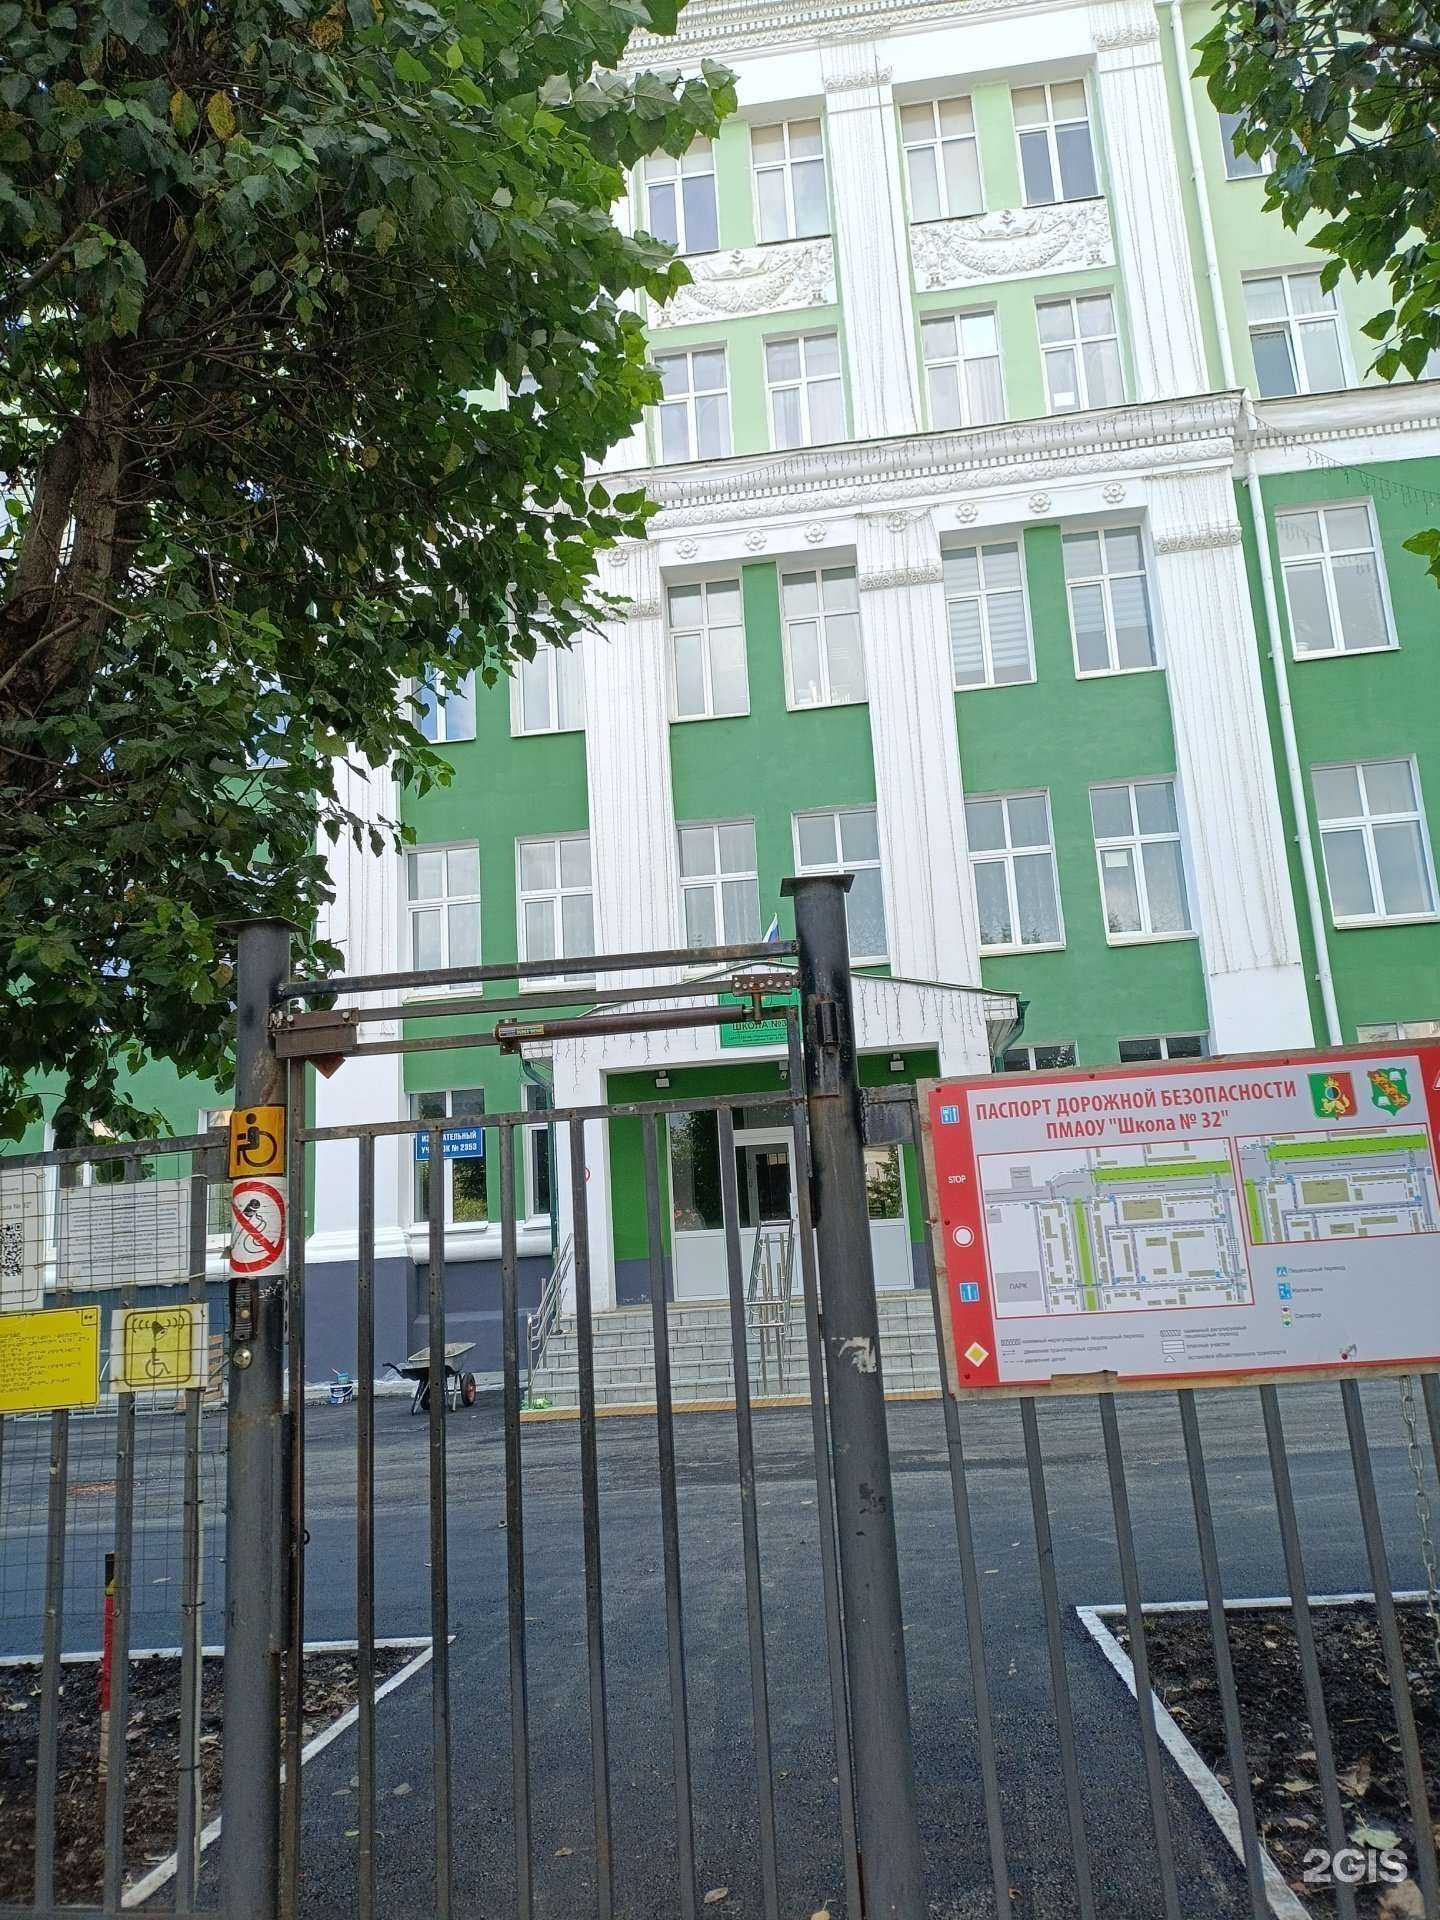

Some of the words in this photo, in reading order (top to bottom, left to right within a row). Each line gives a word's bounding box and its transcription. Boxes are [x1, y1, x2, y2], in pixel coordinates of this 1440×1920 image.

[976, 1099, 1051, 1120] ПАСПОРТ
[1056, 1087, 1156, 1117] ДОРОЖНОЙ
[1161, 1080, 1297, 1107] БЕЗОПАСНОСТИ
[1046, 1118, 1106, 1139] ПМАОУ
[1109, 1117, 1176, 1135] "Школа
[1179, 1113, 1198, 1130] №
[1200, 1109, 1229, 1129] 32"
[947, 1174, 967, 1184] STOP
